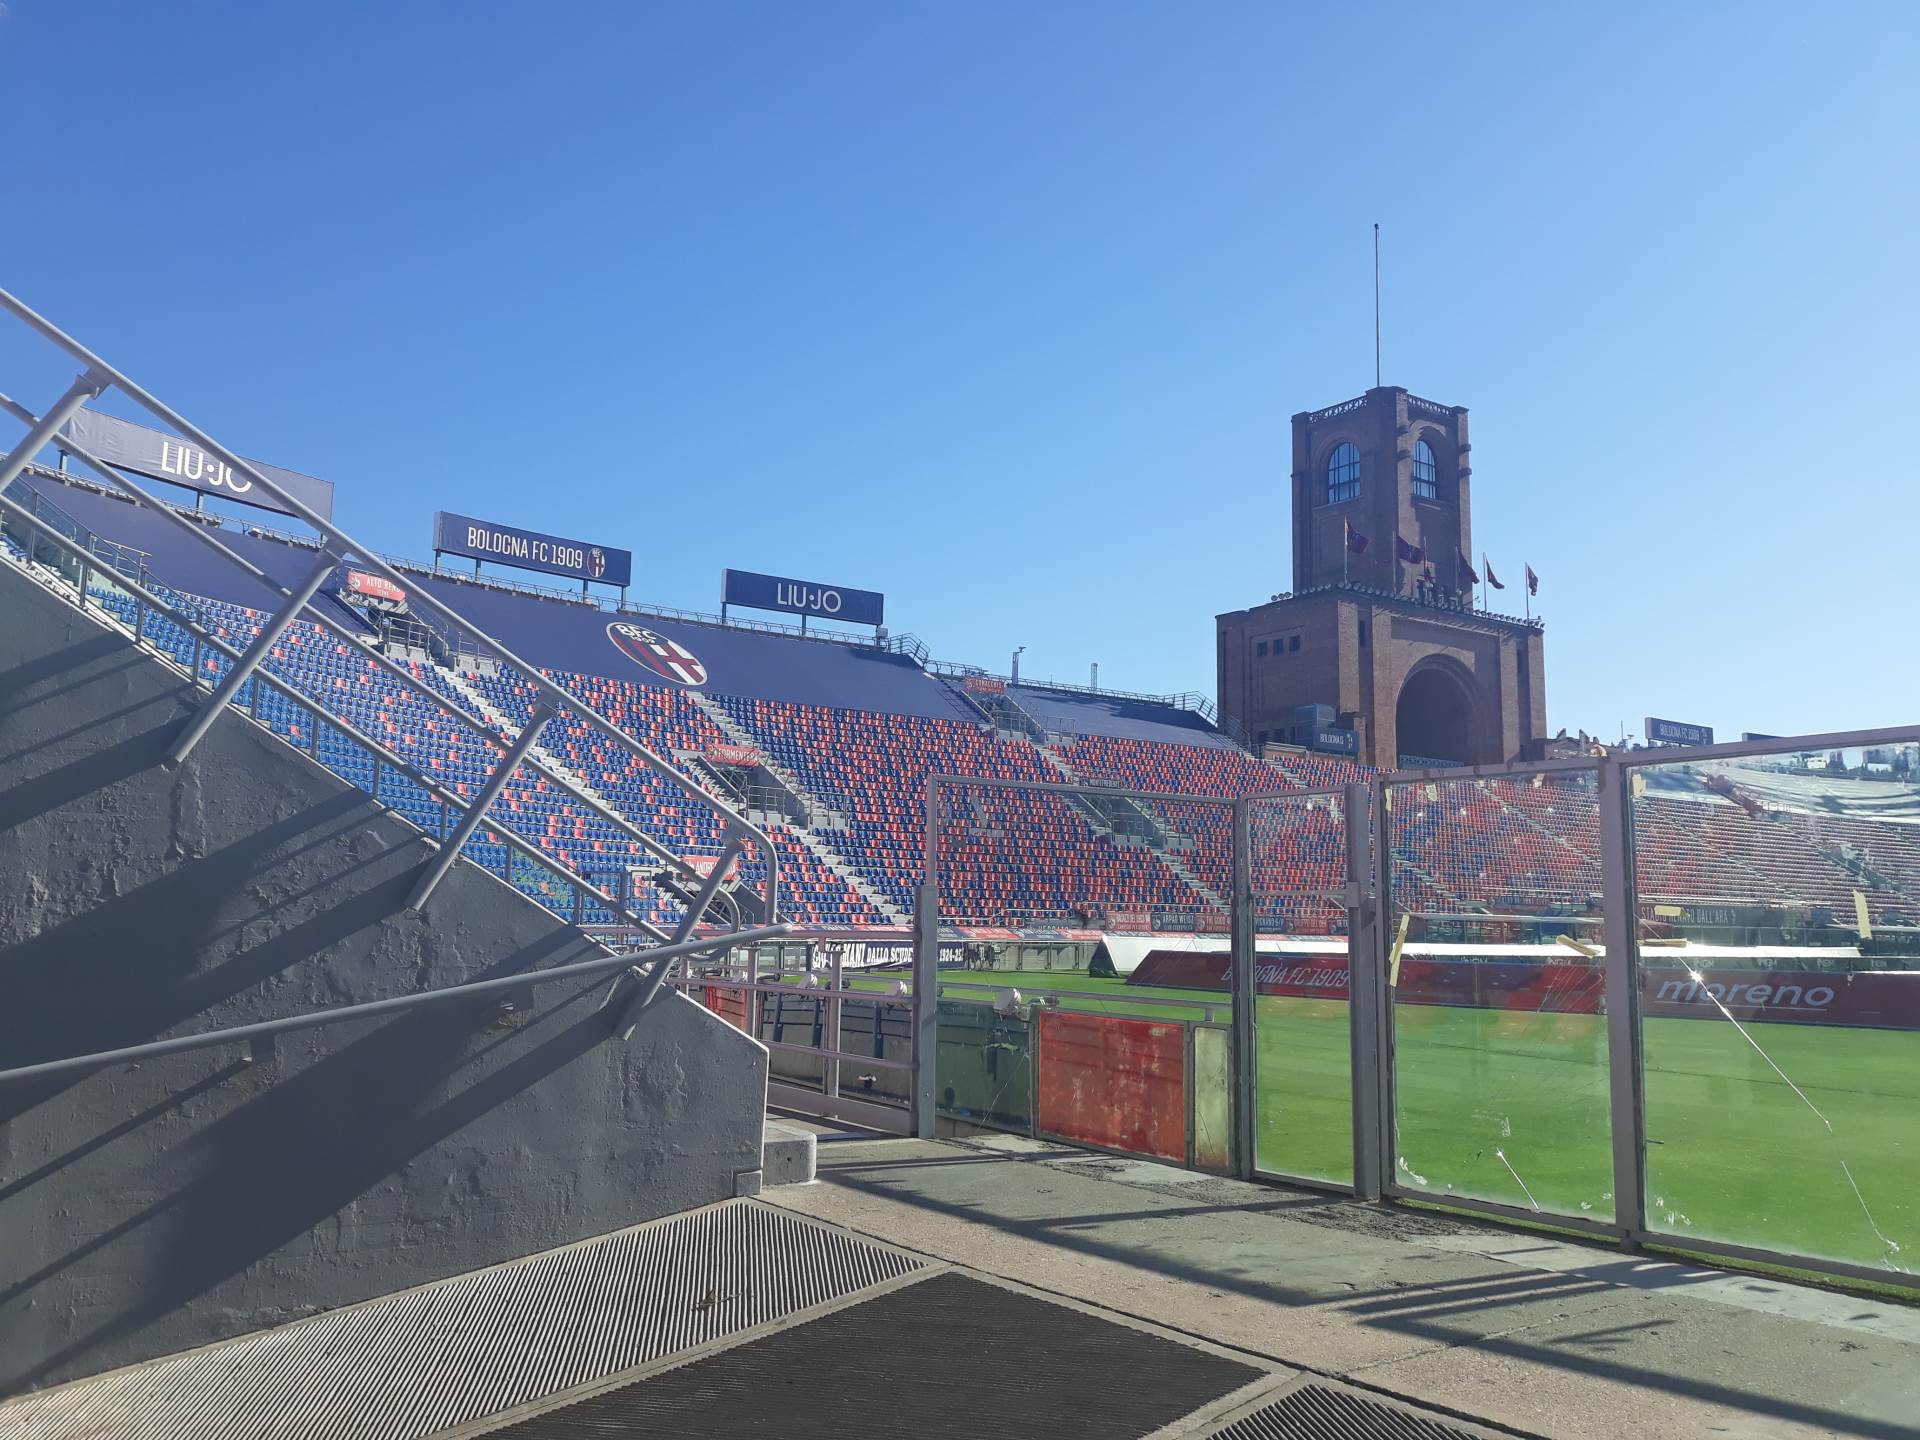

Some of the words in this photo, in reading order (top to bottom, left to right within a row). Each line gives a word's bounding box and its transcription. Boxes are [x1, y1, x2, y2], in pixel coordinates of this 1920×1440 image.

[467, 526, 529, 559] BOLOGNA
[532, 541, 549, 562] FC
[551, 544, 583, 569] 1909
[366, 576, 383, 588] ALTO
[615, 624, 657, 640] BFC
[867, 947, 890, 963] DALLO
[890, 947, 913, 963] SCUDE
[1285, 967, 1311, 985] FC
[1308, 967, 1350, 988] 1909
[1656, 979, 1835, 1007] moreno
